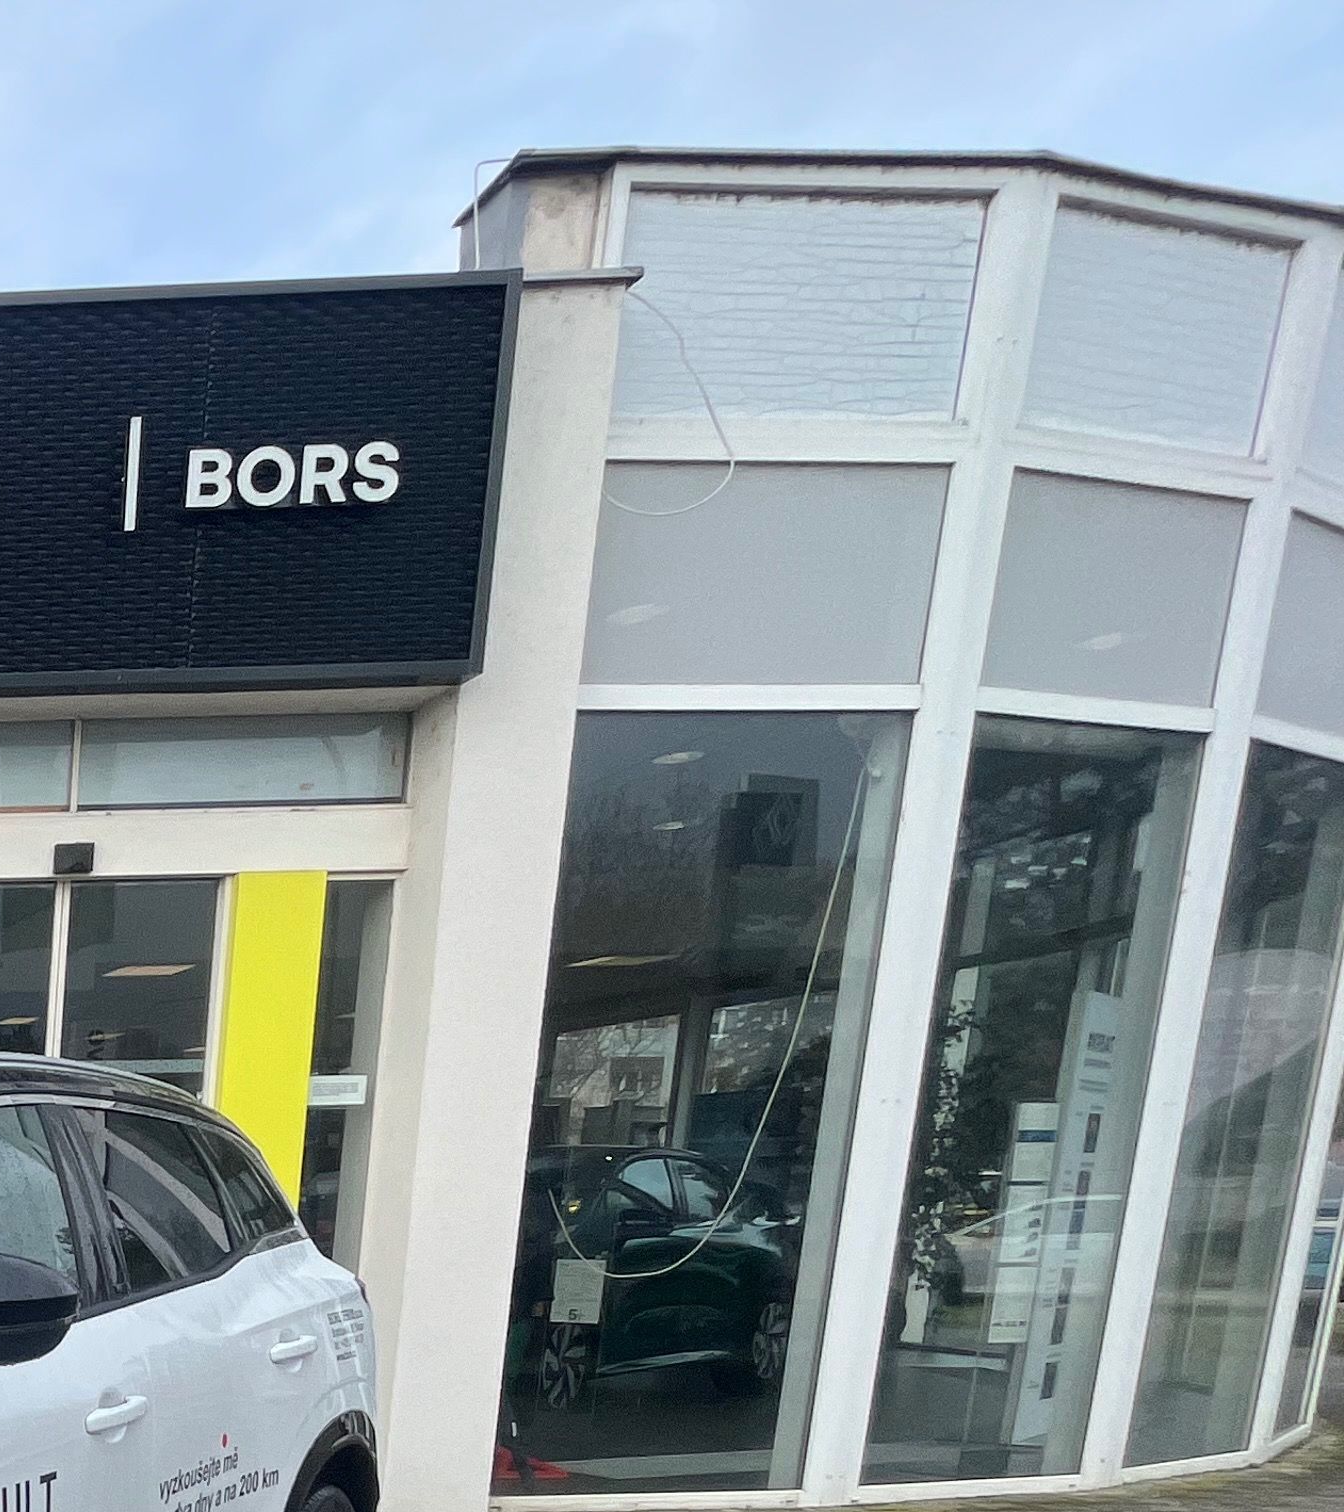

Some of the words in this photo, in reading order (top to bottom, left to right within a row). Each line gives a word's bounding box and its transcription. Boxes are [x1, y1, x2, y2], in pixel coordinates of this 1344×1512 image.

[185, 441, 400, 508] BORS
[159, 1457, 221, 1504] vyzkoušejte
[223, 1446, 239, 1474] mě
[215, 1489, 222, 1507] a
[224, 1483, 237, 1503] na
[239, 1470, 259, 1497] 200
[262, 1468, 279, 1490] km
